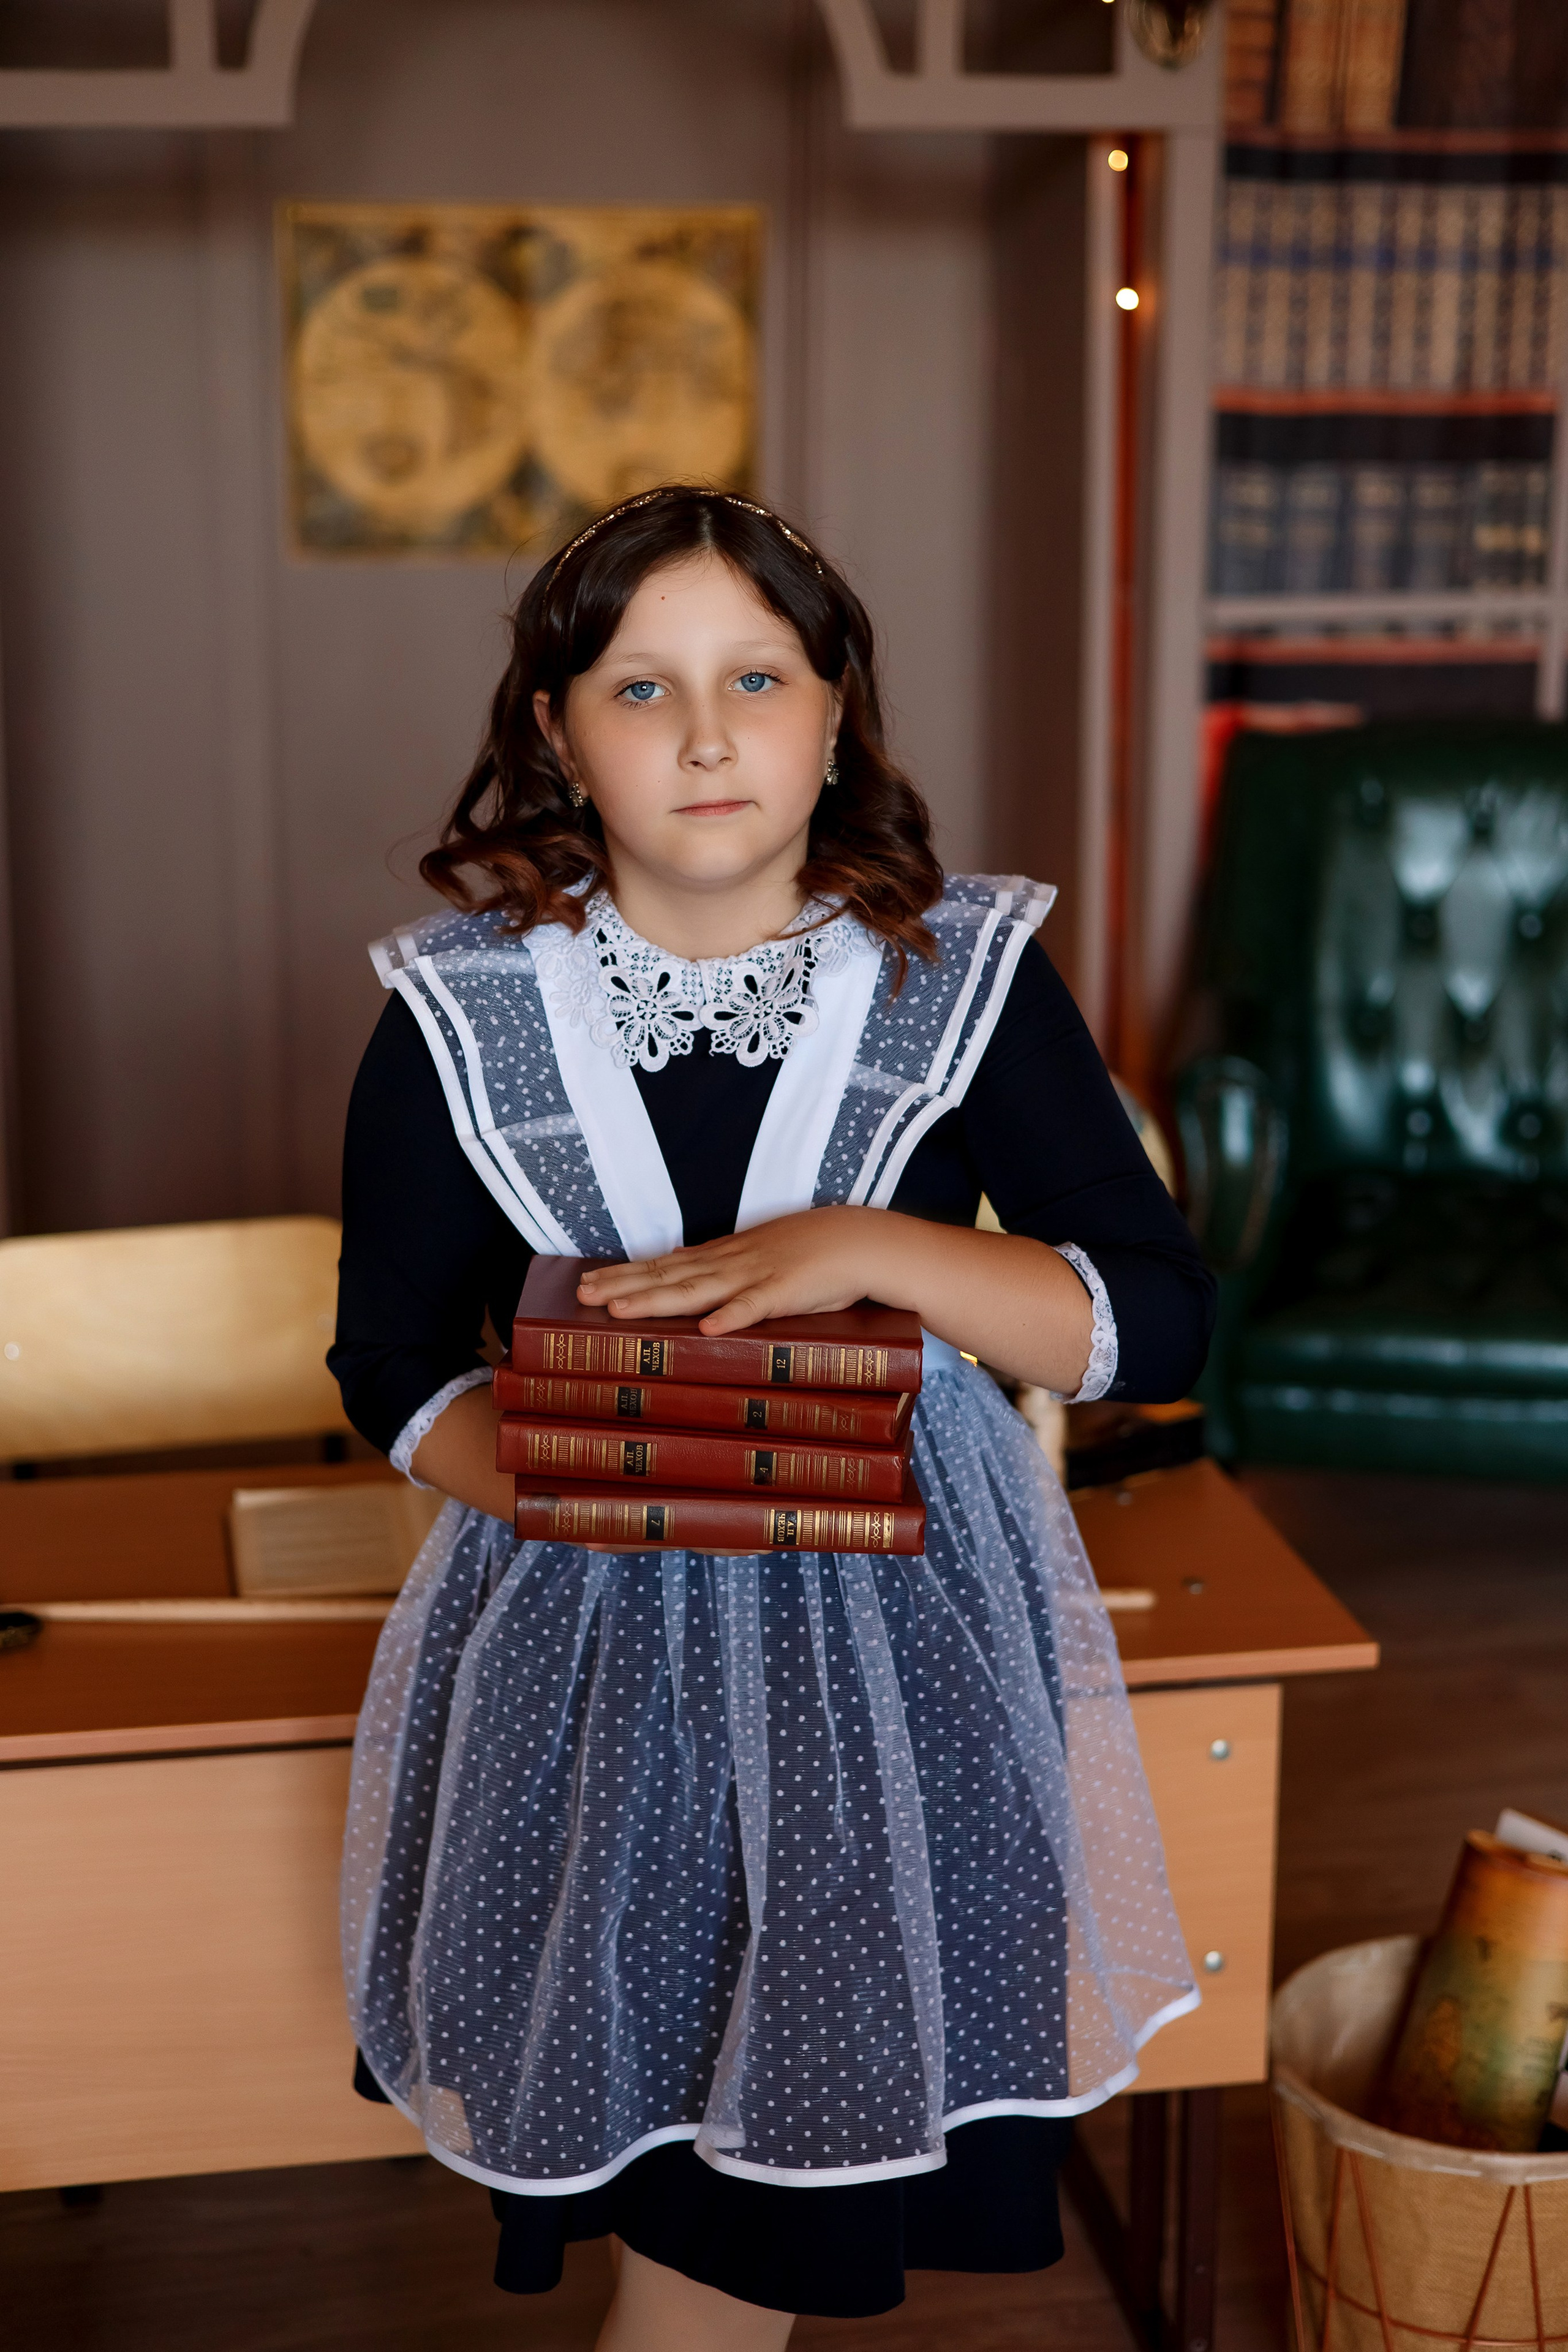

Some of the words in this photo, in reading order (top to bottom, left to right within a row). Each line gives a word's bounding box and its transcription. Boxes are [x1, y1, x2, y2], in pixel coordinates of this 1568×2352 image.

[652, 1342, 660, 1371] ЧЕХОВ
[776, 1359, 786, 1369] 12
[777, 1513, 786, 1542] ЧЕХОВ
